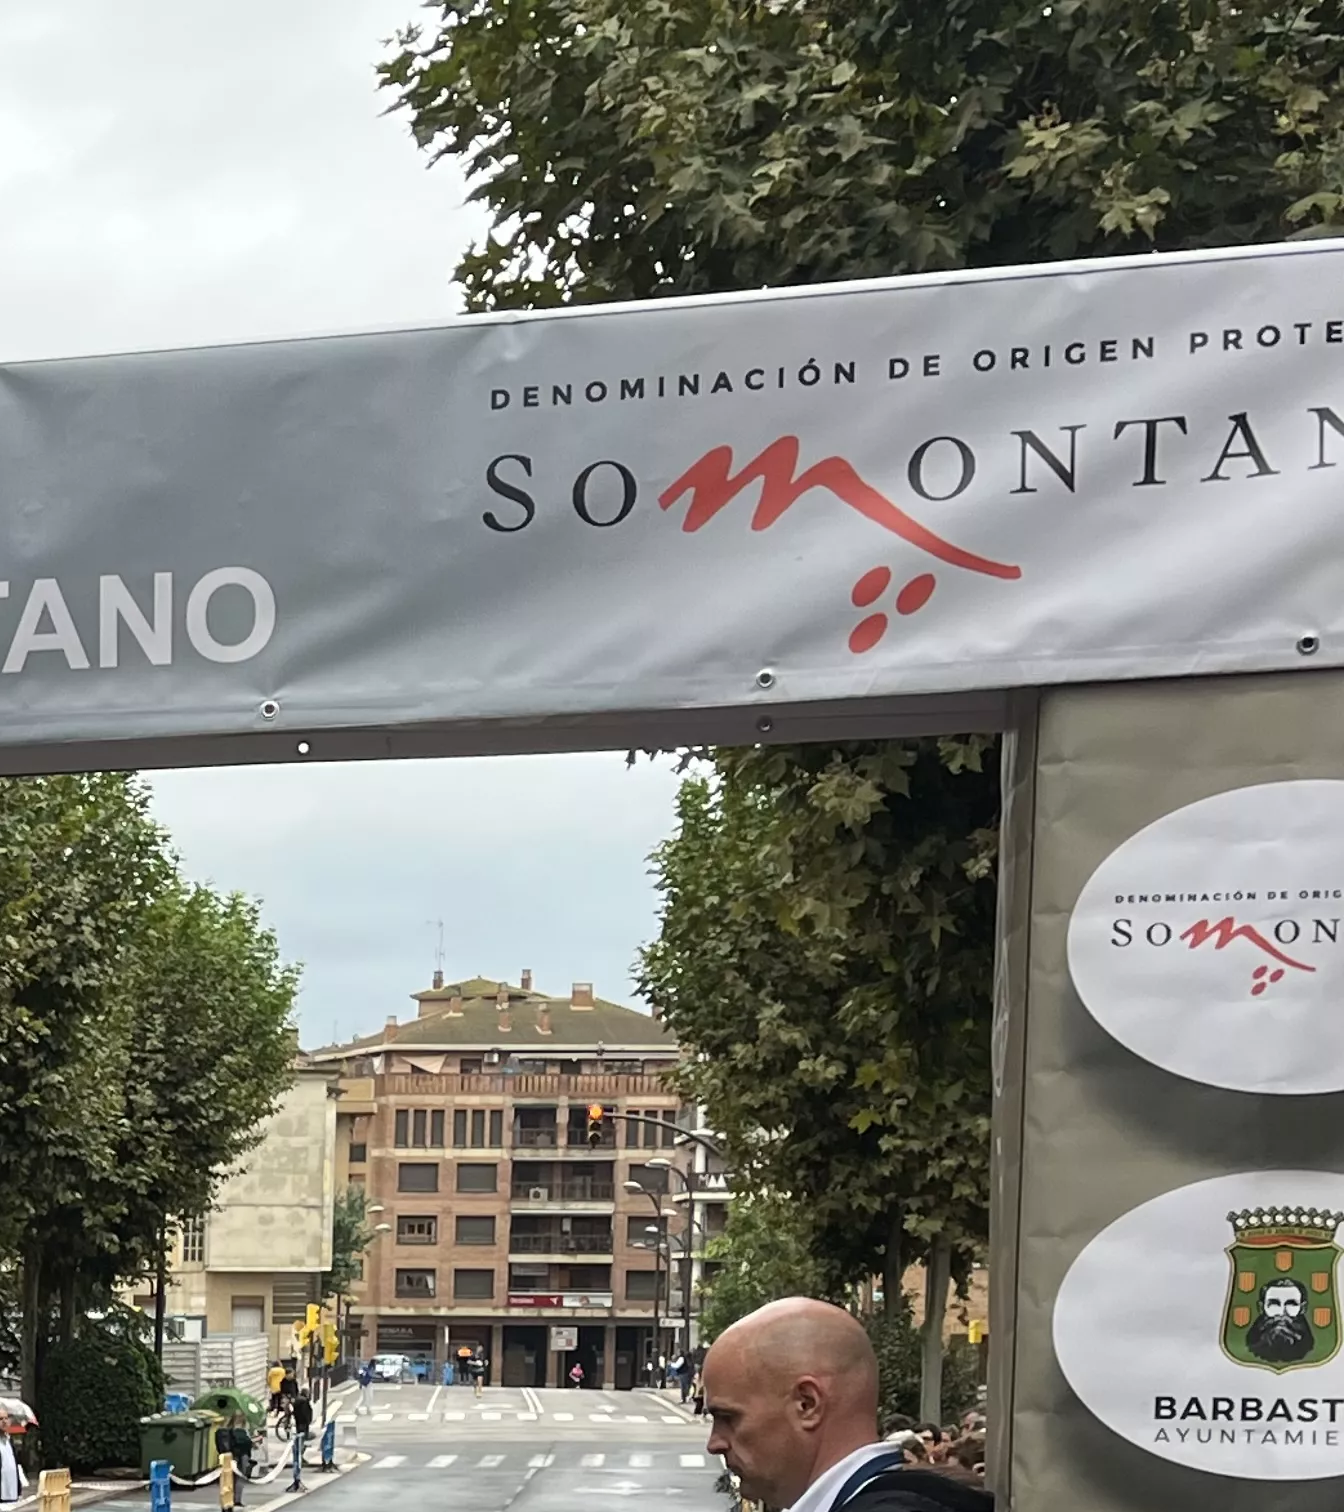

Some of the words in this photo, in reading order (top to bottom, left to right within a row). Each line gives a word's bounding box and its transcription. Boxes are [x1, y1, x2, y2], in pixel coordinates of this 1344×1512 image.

[490, 356, 858, 412] DENOMINACIÓN
[889, 353, 943, 381] DE
[973, 334, 1157, 375] ORIGEN
[1188, 319, 1344, 357] PROTE
[1114, 889, 1258, 904] DENOMINACIÓN
[1267, 890, 1289, 900] DE
[1298, 888, 1343, 900] ORIG
[1153, 1396, 1344, 1424] BARBAST
[1153, 1427, 1340, 1447] AYUNTAMIE
